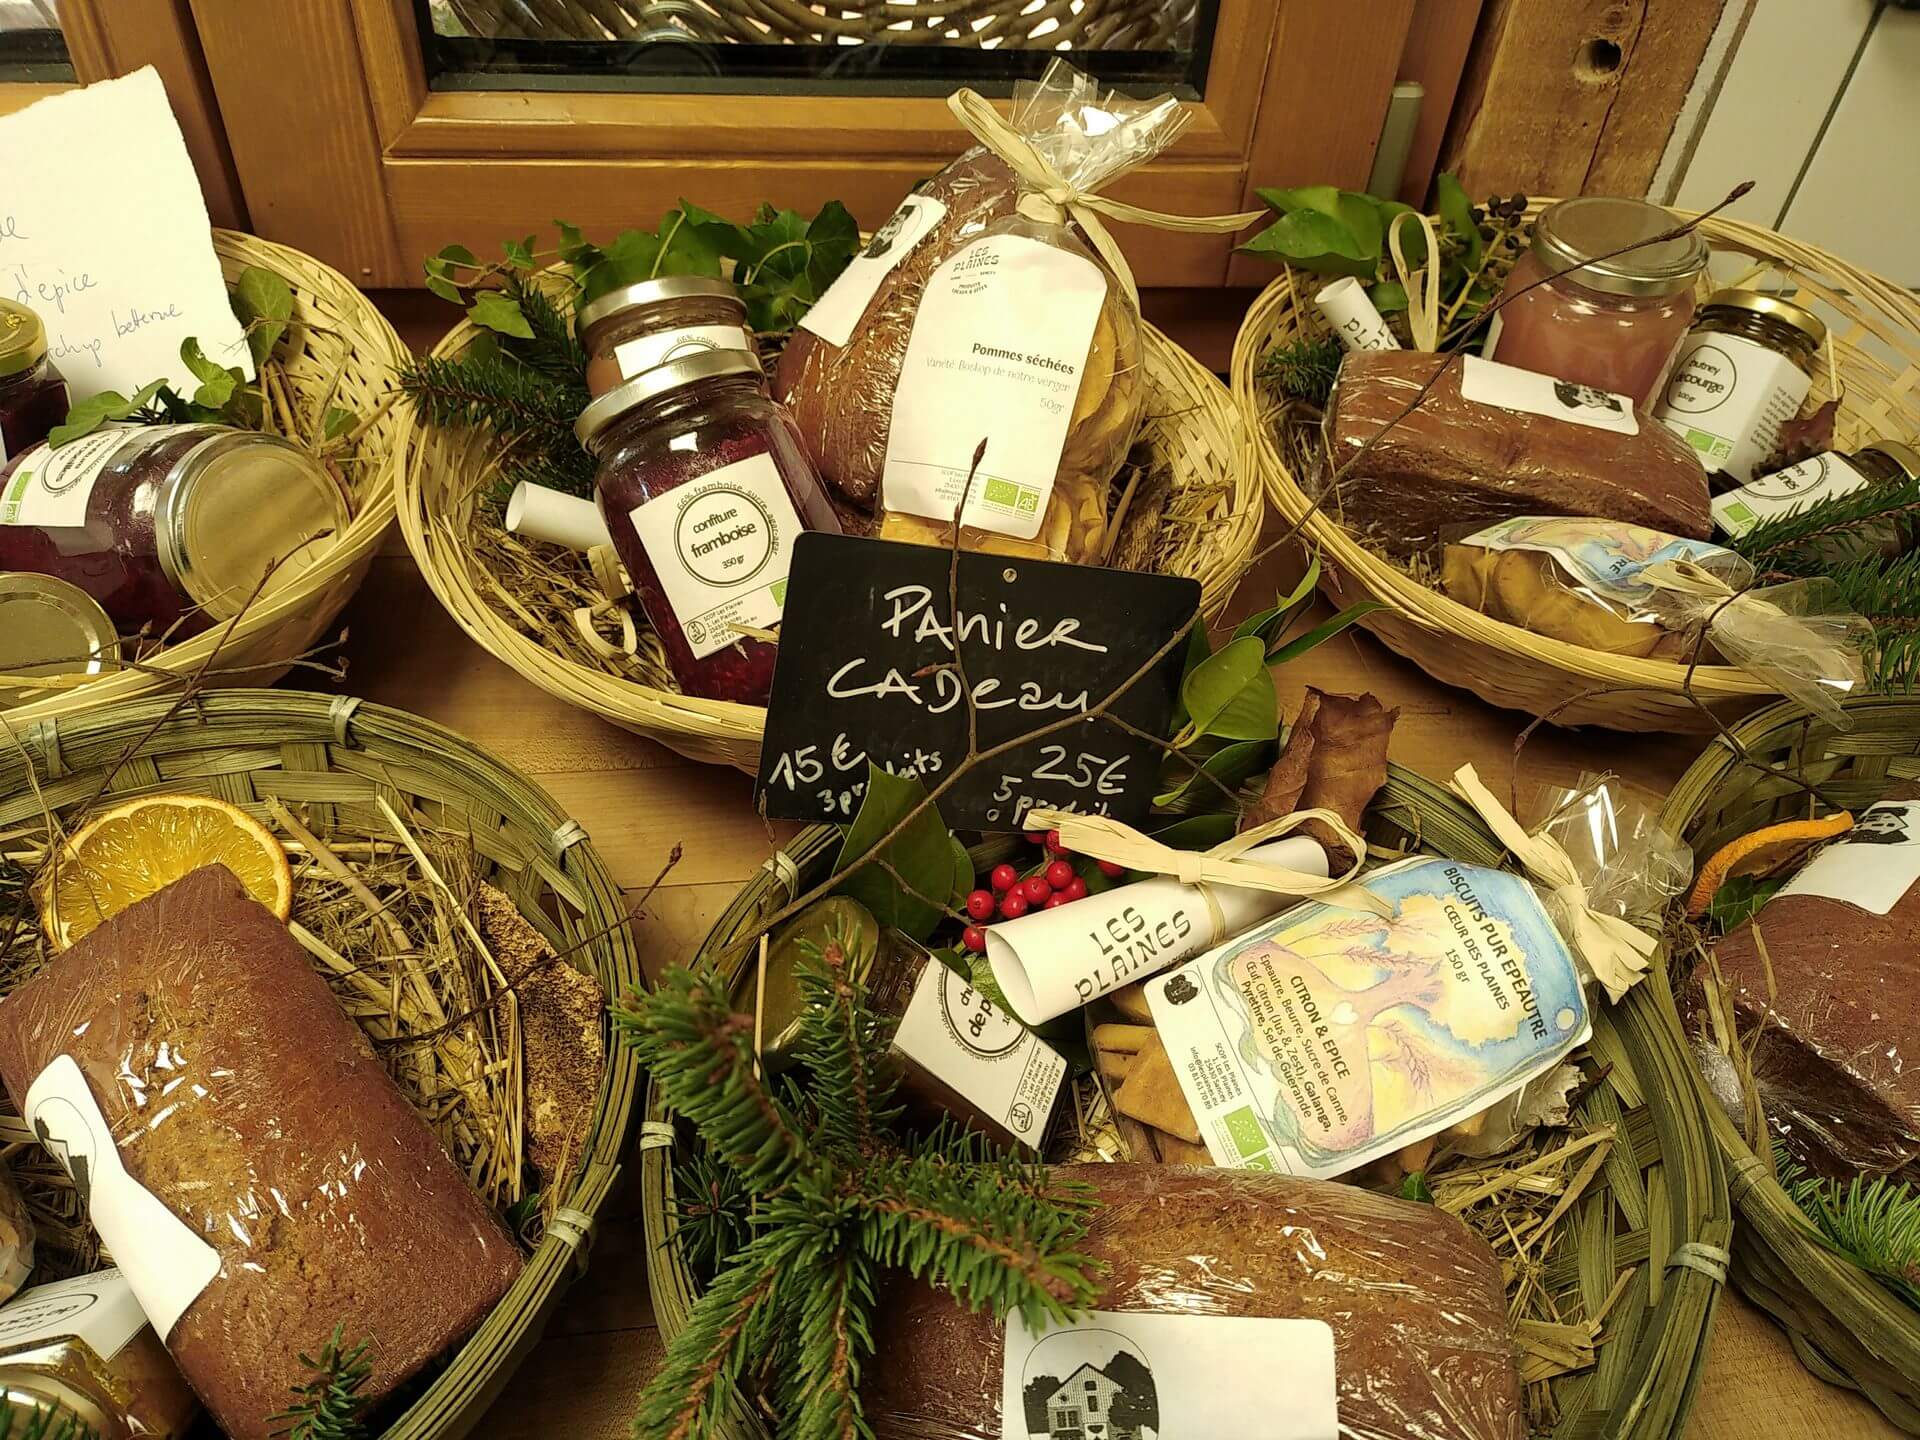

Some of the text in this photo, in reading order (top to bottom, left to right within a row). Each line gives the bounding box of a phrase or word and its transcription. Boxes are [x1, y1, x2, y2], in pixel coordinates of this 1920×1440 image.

[972, 342, 1075, 375] Pommes séchées
[993, 367, 1003, 376] de
[1008, 369, 1034, 383] notre
[1037, 377, 1071, 392] verger
[677, 492, 694, 510] 66%
[692, 508, 739, 534] confiture
[691, 522, 757, 559] framboise
[1089, 906, 1145, 956] LES
[1074, 910, 1191, 1004] PLAINES
[1443, 867, 1548, 1041] BISCUITS PUR EPEAUTRE
[1443, 904, 1510, 1011] CŒUR DES PLAINES
[1445, 948, 1470, 983] 150 gr
[968, 1013, 986, 1038] de
[1260, 953, 1348, 1126] Epeautre, Beurre, Sucre de Canne,
[1290, 975, 1350, 1080] CITRON & EPICE
[1256, 984, 1275, 1014] Citron
[1269, 1014, 1286, 1036] (Jus
[1281, 1036, 1293, 1048] &
[1304, 1081, 1333, 1132] Galanga,
[1262, 1027, 1277, 1044] Sel
[1272, 1045, 1284, 1061] de
[1219, 1074, 1236, 1099] Plaines
[1227, 1071, 1243, 1096] Plaines
